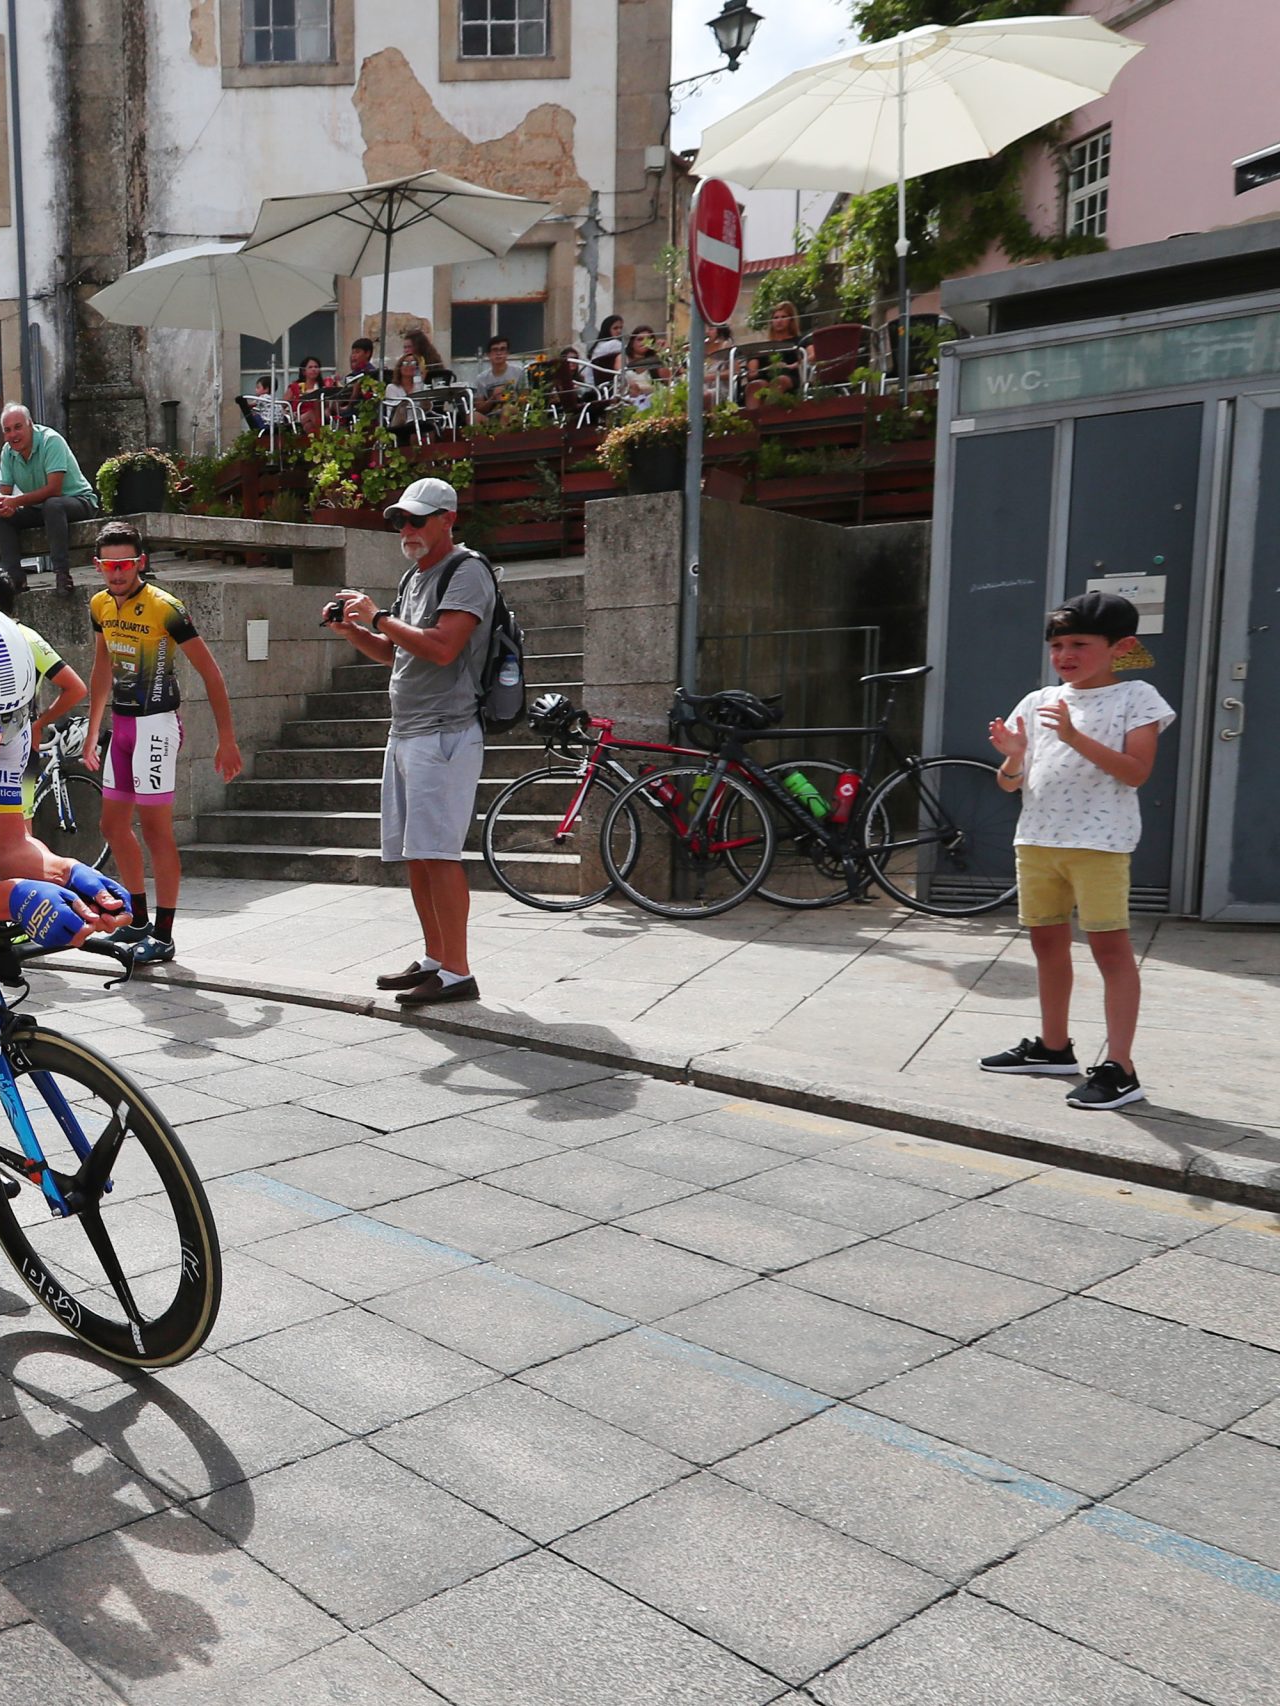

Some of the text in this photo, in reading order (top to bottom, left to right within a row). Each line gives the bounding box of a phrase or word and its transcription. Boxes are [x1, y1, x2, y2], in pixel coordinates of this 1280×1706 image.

[986, 370, 1050, 394] W.C.
[120, 619, 150, 635] QUARTAS
[150, 735, 163, 774] ABTF
[25, 898, 54, 939] W52
